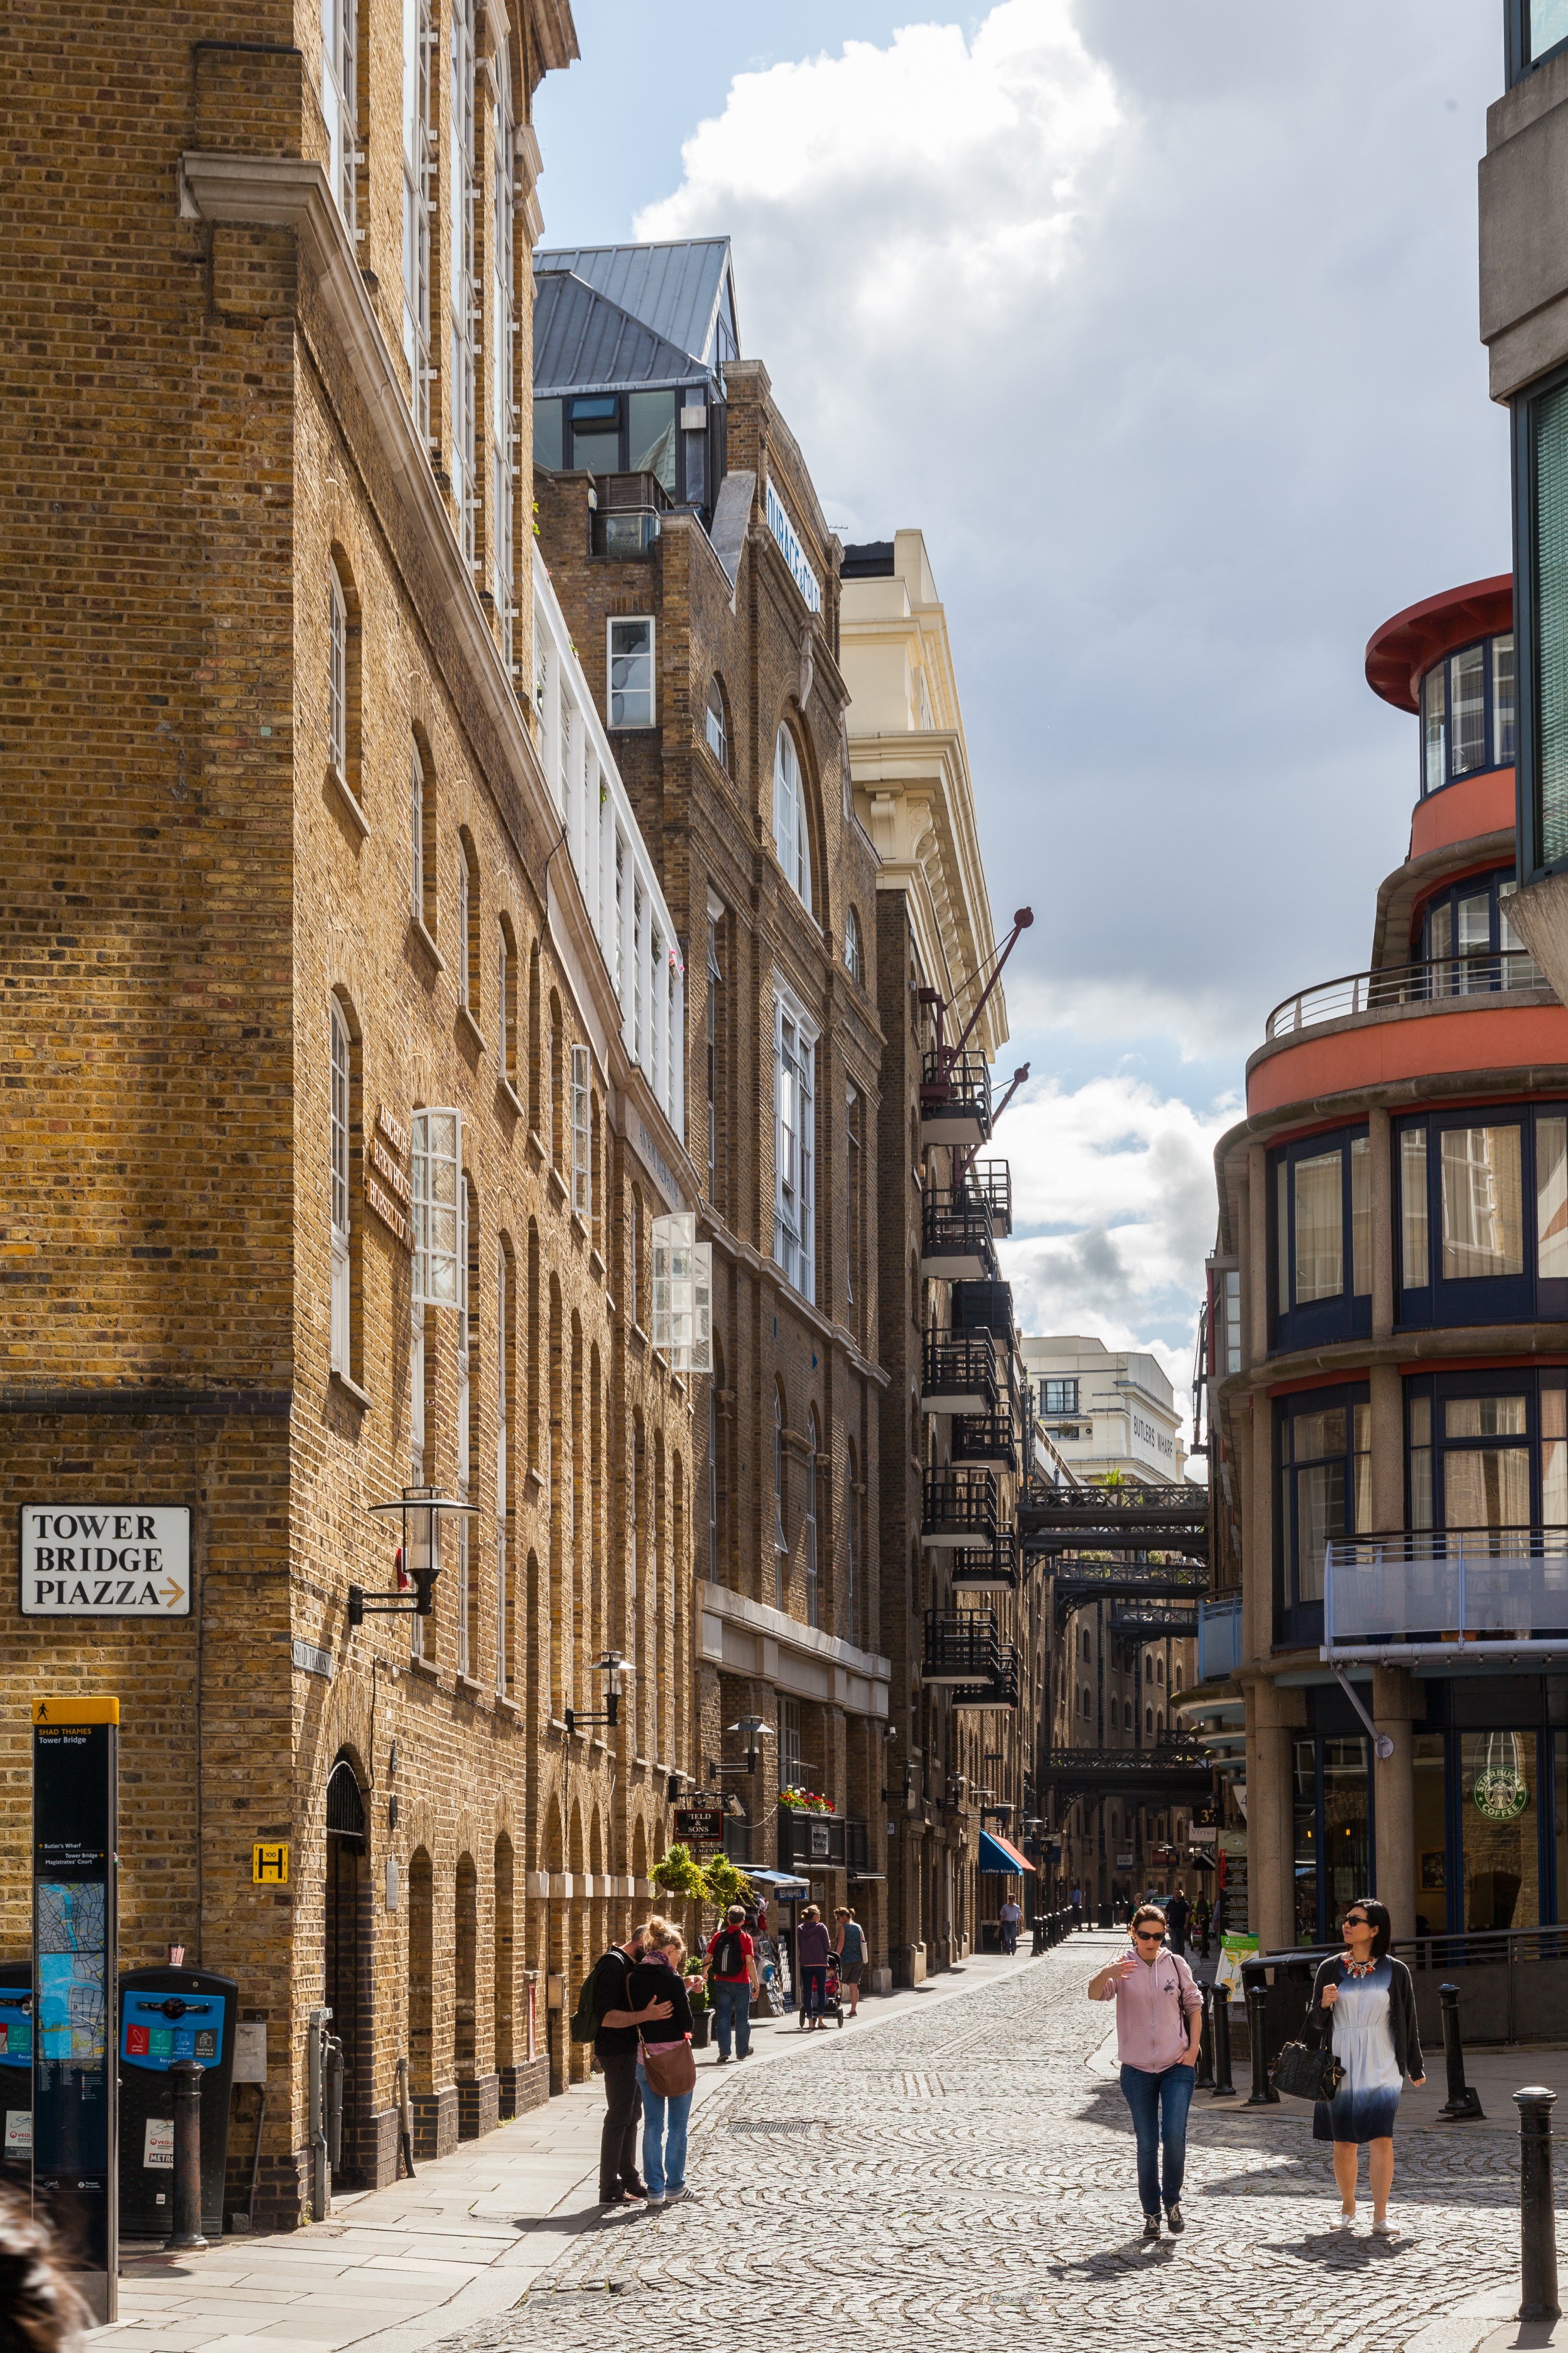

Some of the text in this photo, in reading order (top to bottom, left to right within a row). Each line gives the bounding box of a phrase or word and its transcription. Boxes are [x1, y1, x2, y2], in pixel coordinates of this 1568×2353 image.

[379, 1103, 408, 1159] ANCHOR
[1133, 1415, 1173, 1459] BUTLERS WHARF
[32, 1514, 158, 1539] TOWER
[34, 1547, 164, 1572] BRIDGE
[34, 1580, 161, 1605] PIAZZA
[295, 1643, 327, 1673] SHAD THAMES
[63, 1737, 87, 1745] Bridge
[1476, 1769, 1524, 1792] STARBUCKS
[1482, 1803, 1519, 1817] COFFEE
[258, 1848, 283, 1879] H
